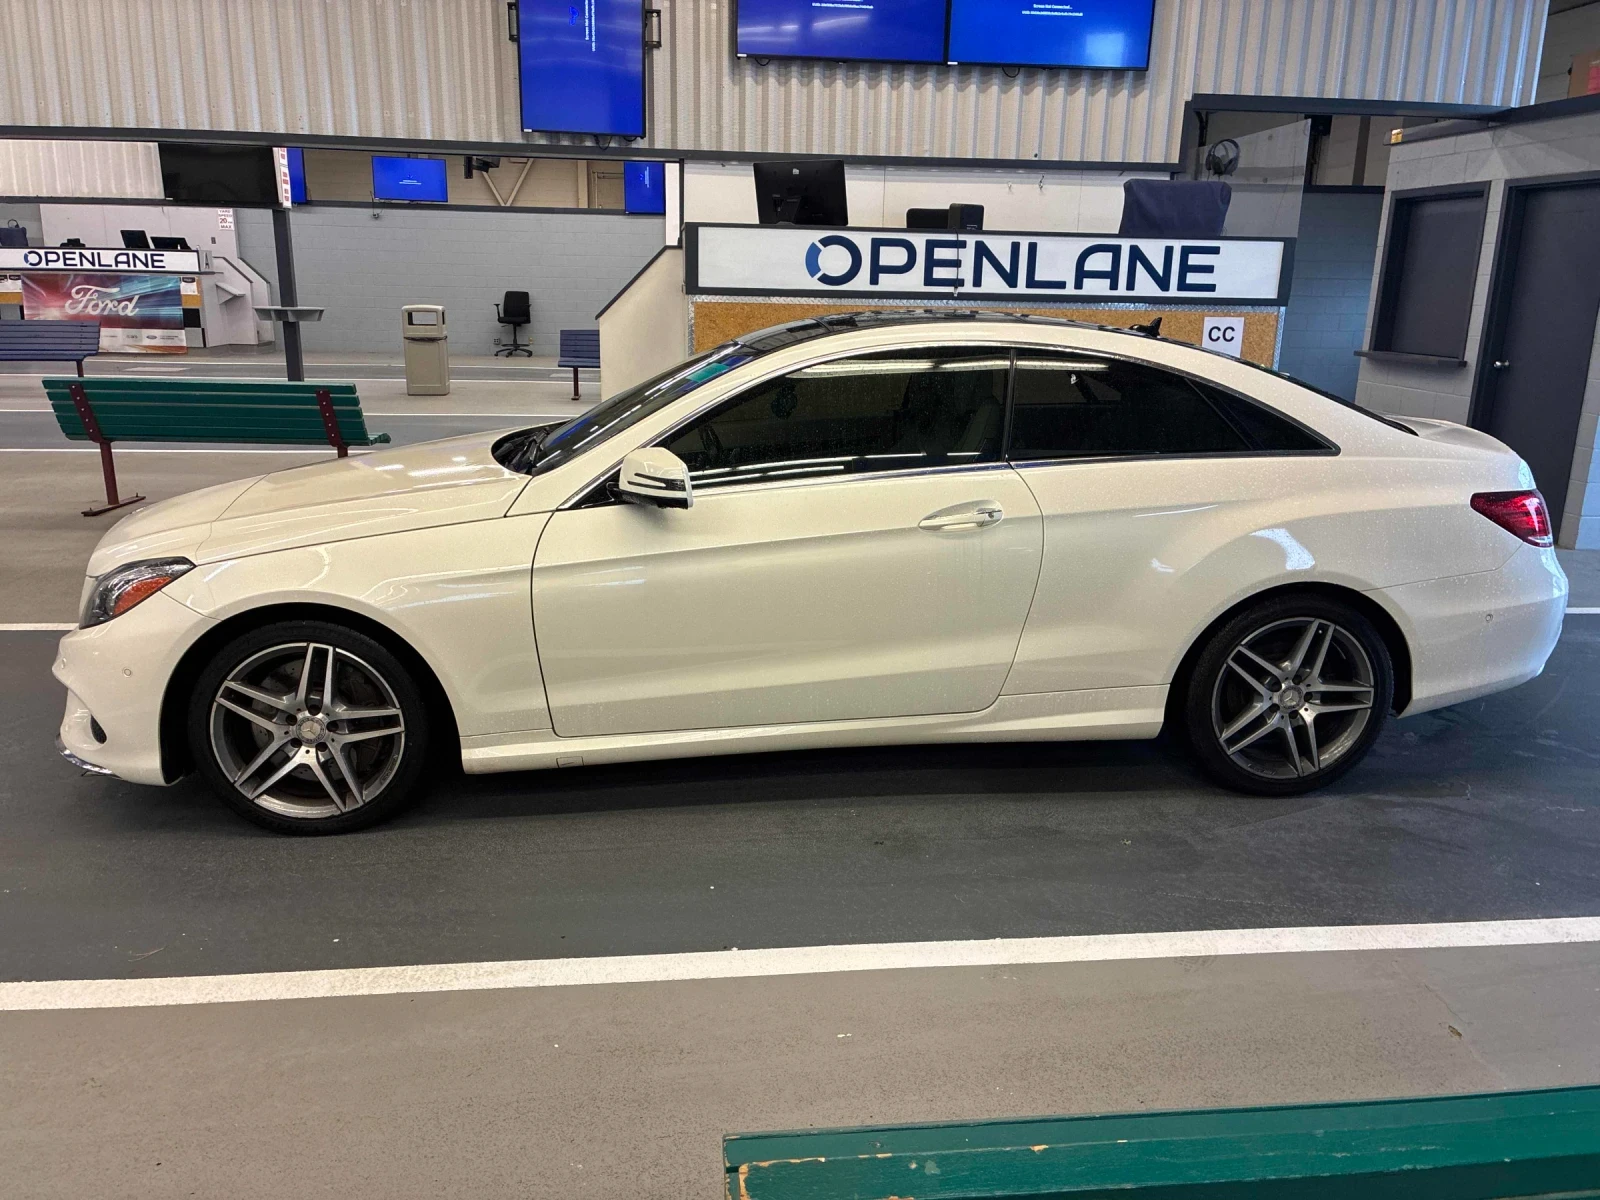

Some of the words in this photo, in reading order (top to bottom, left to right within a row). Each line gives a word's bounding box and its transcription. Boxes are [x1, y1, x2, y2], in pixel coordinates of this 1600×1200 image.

[24, 250, 165, 269] OPENLANE
[805, 235, 1220, 292] OPENLANE
[65, 285, 139, 317] Ford
[1208, 325, 1236, 343] CC
